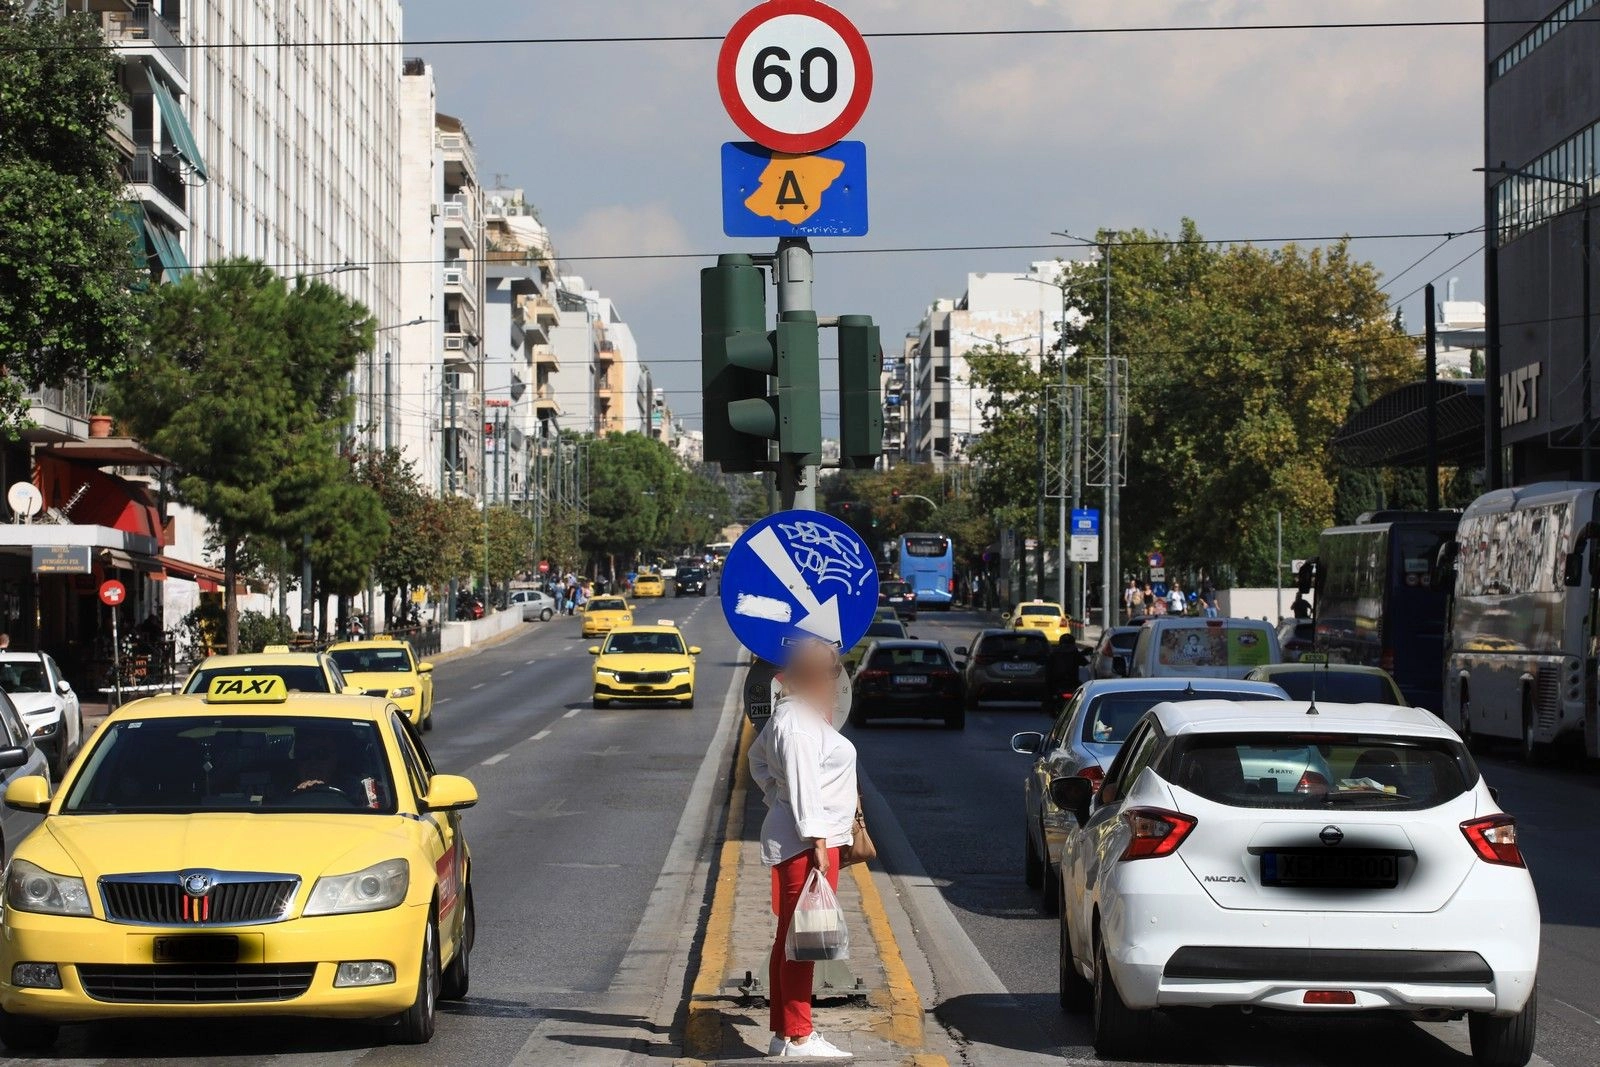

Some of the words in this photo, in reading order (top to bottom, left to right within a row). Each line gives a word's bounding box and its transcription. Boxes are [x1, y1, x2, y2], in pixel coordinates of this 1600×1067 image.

[752, 45, 838, 103] 60
[776, 170, 806, 205] Δ
[214, 679, 276, 695] TAXI
[1204, 875, 1247, 884] MICRA
